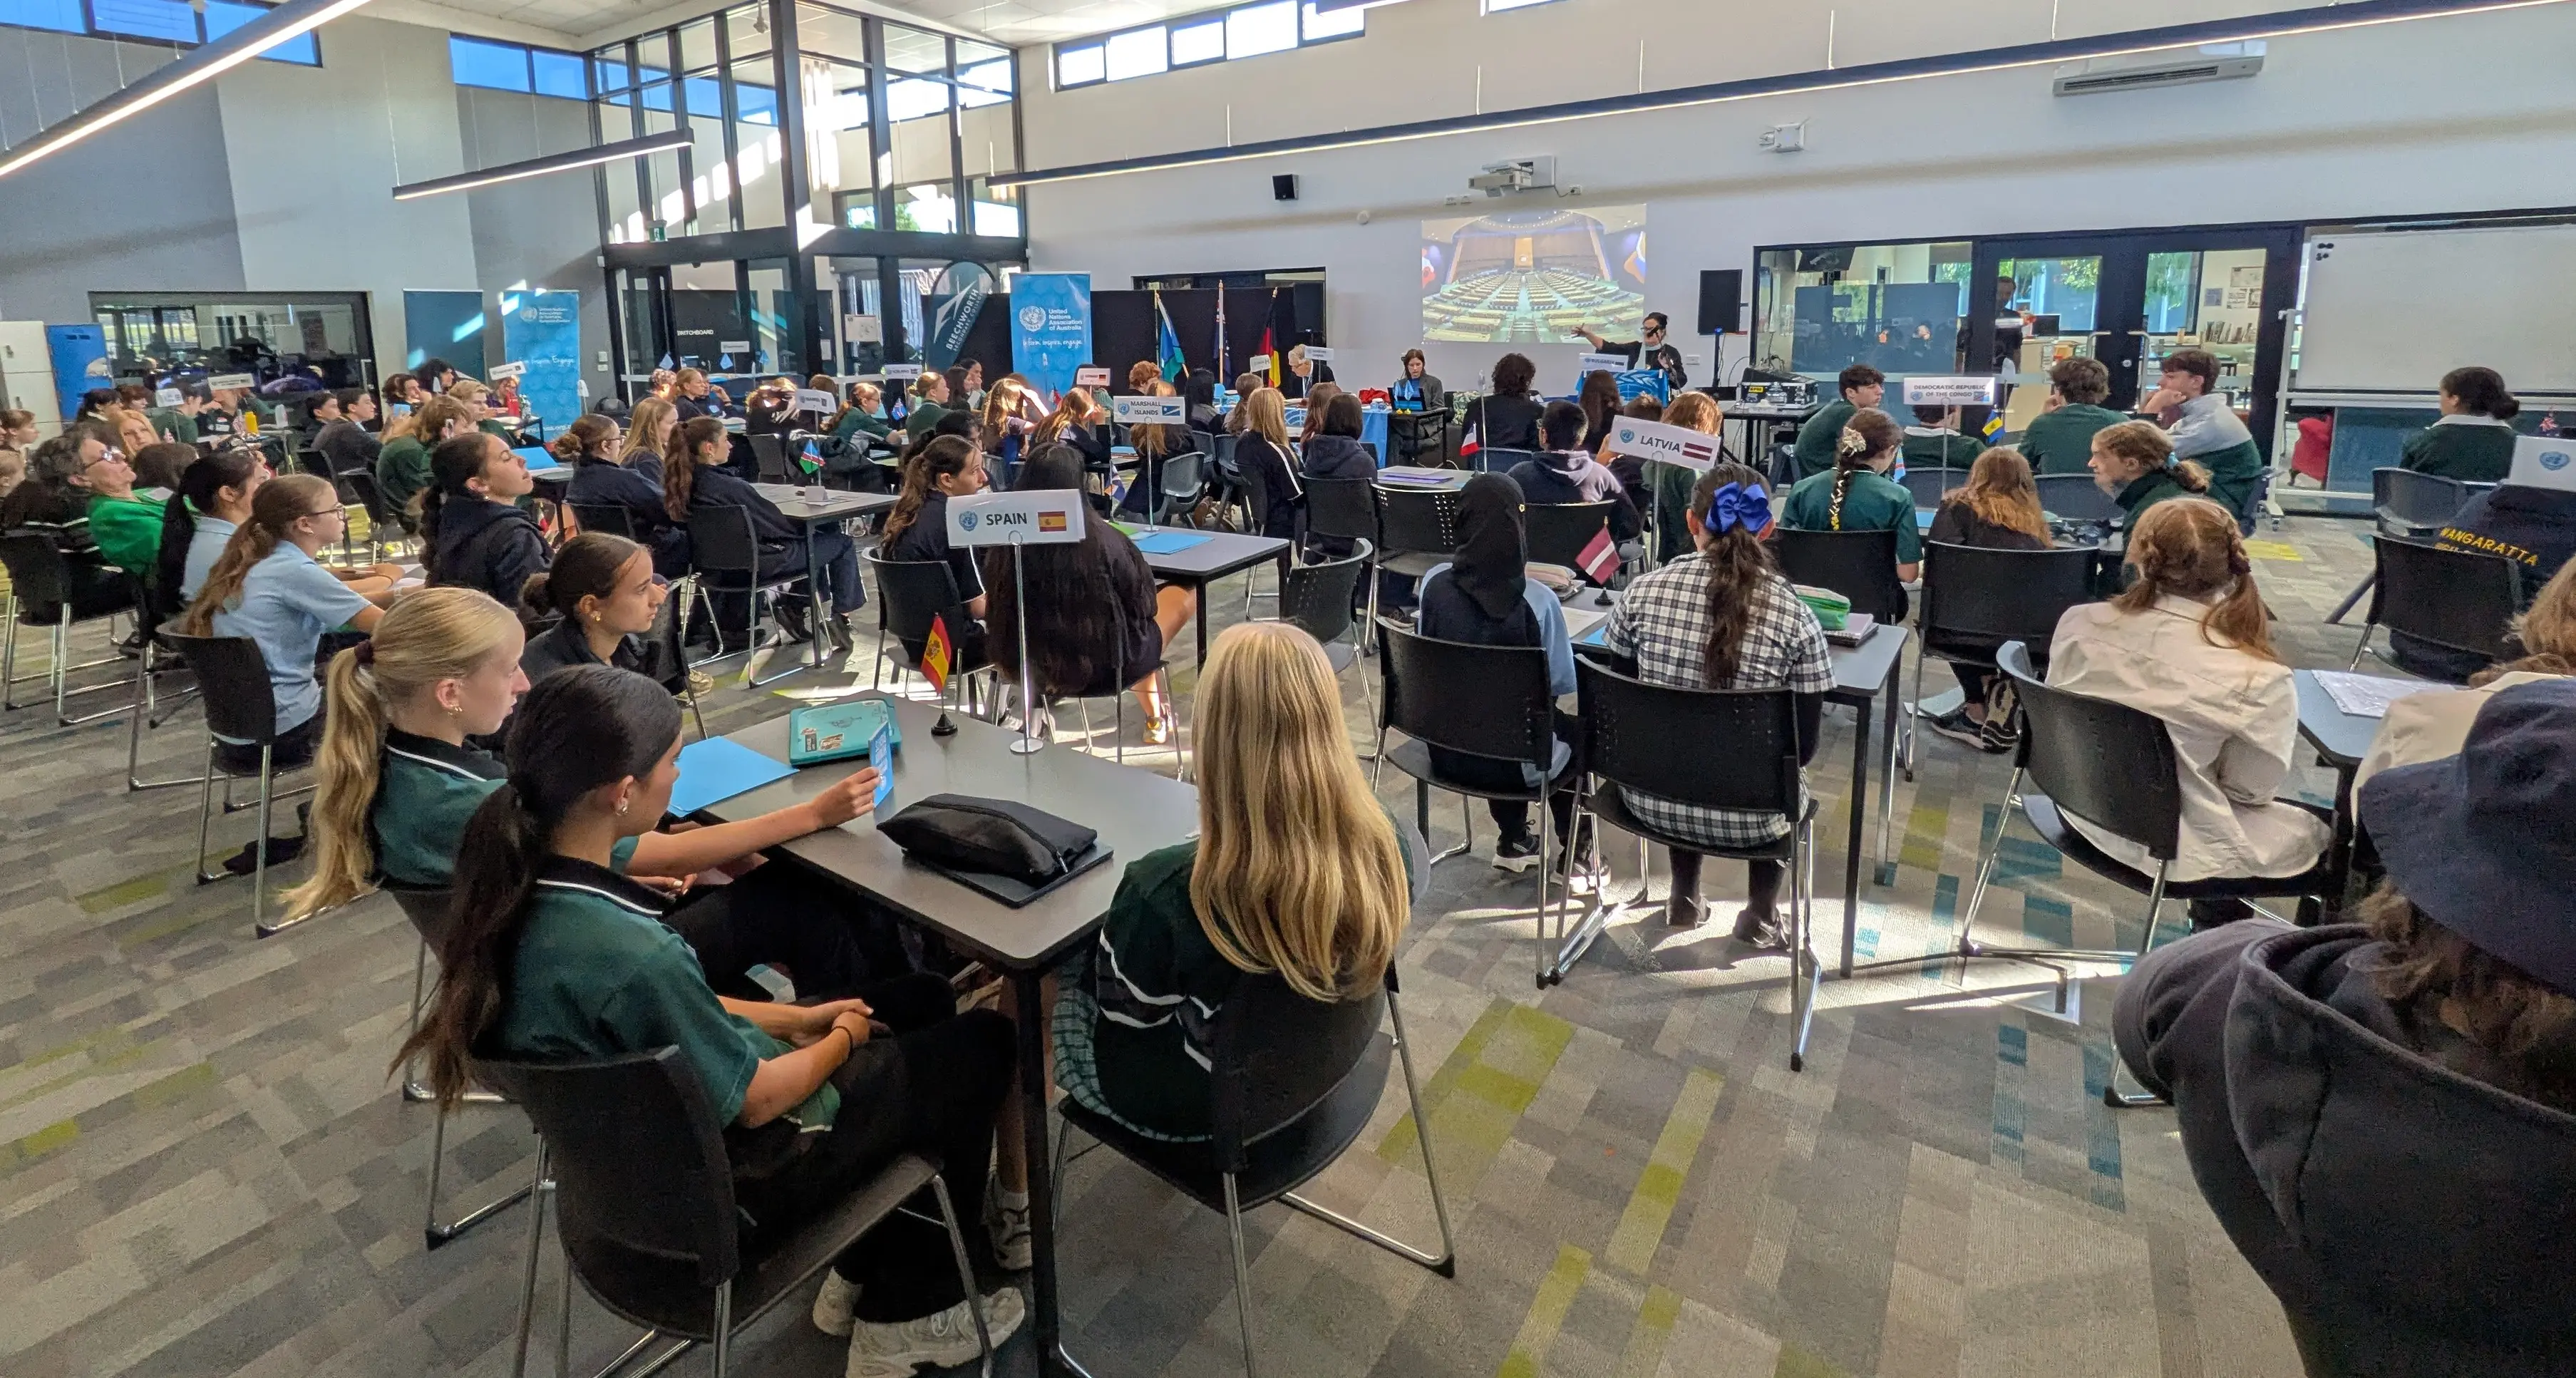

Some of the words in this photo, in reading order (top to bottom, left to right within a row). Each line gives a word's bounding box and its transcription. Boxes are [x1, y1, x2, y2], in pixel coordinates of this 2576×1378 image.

[946, 289, 979, 350] BEECHWORTH
[1640, 435, 1681, 453] LATVIA
[986, 512, 1028, 526] SPAIN
[2440, 527, 2539, 567] WANGARATTA
